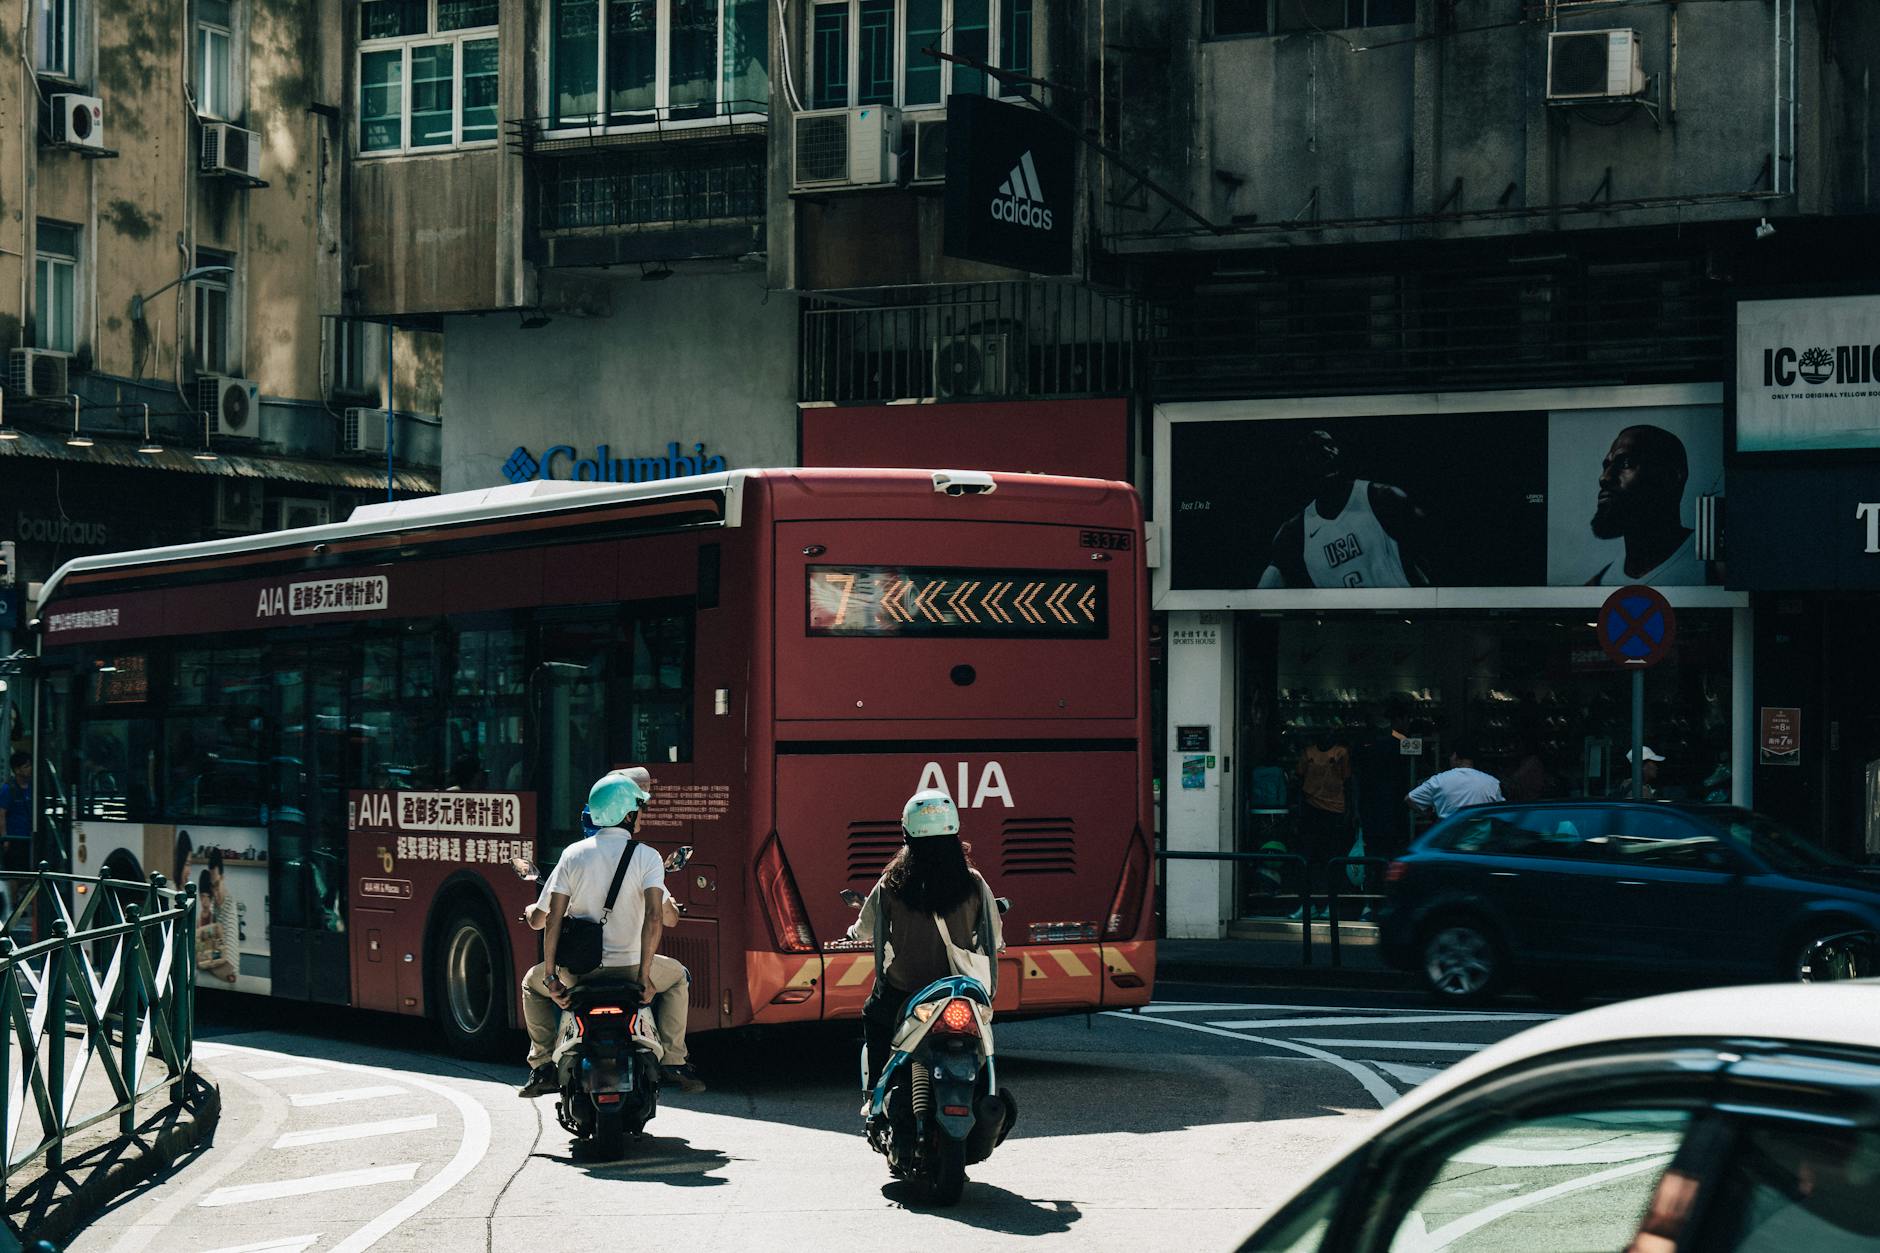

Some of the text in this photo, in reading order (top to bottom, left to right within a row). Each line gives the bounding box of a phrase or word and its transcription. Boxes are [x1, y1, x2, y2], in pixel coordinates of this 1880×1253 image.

[990, 196, 1053, 231] adidas
[539, 441, 727, 483] Columbia
[1179, 501, 1194, 512] Just
[1194, 501, 1204, 510] Do
[17, 511, 107, 545] bauhaus
[1081, 531, 1130, 551] E3373
[1324, 532, 1363, 568] USA
[256, 586, 285, 617] AIA
[825, 574, 855, 625] 7
[916, 761, 1015, 809] AIA
[358, 793, 393, 827] AIA
[403, 797, 514, 827] 盈御多元貨幣計劃3
